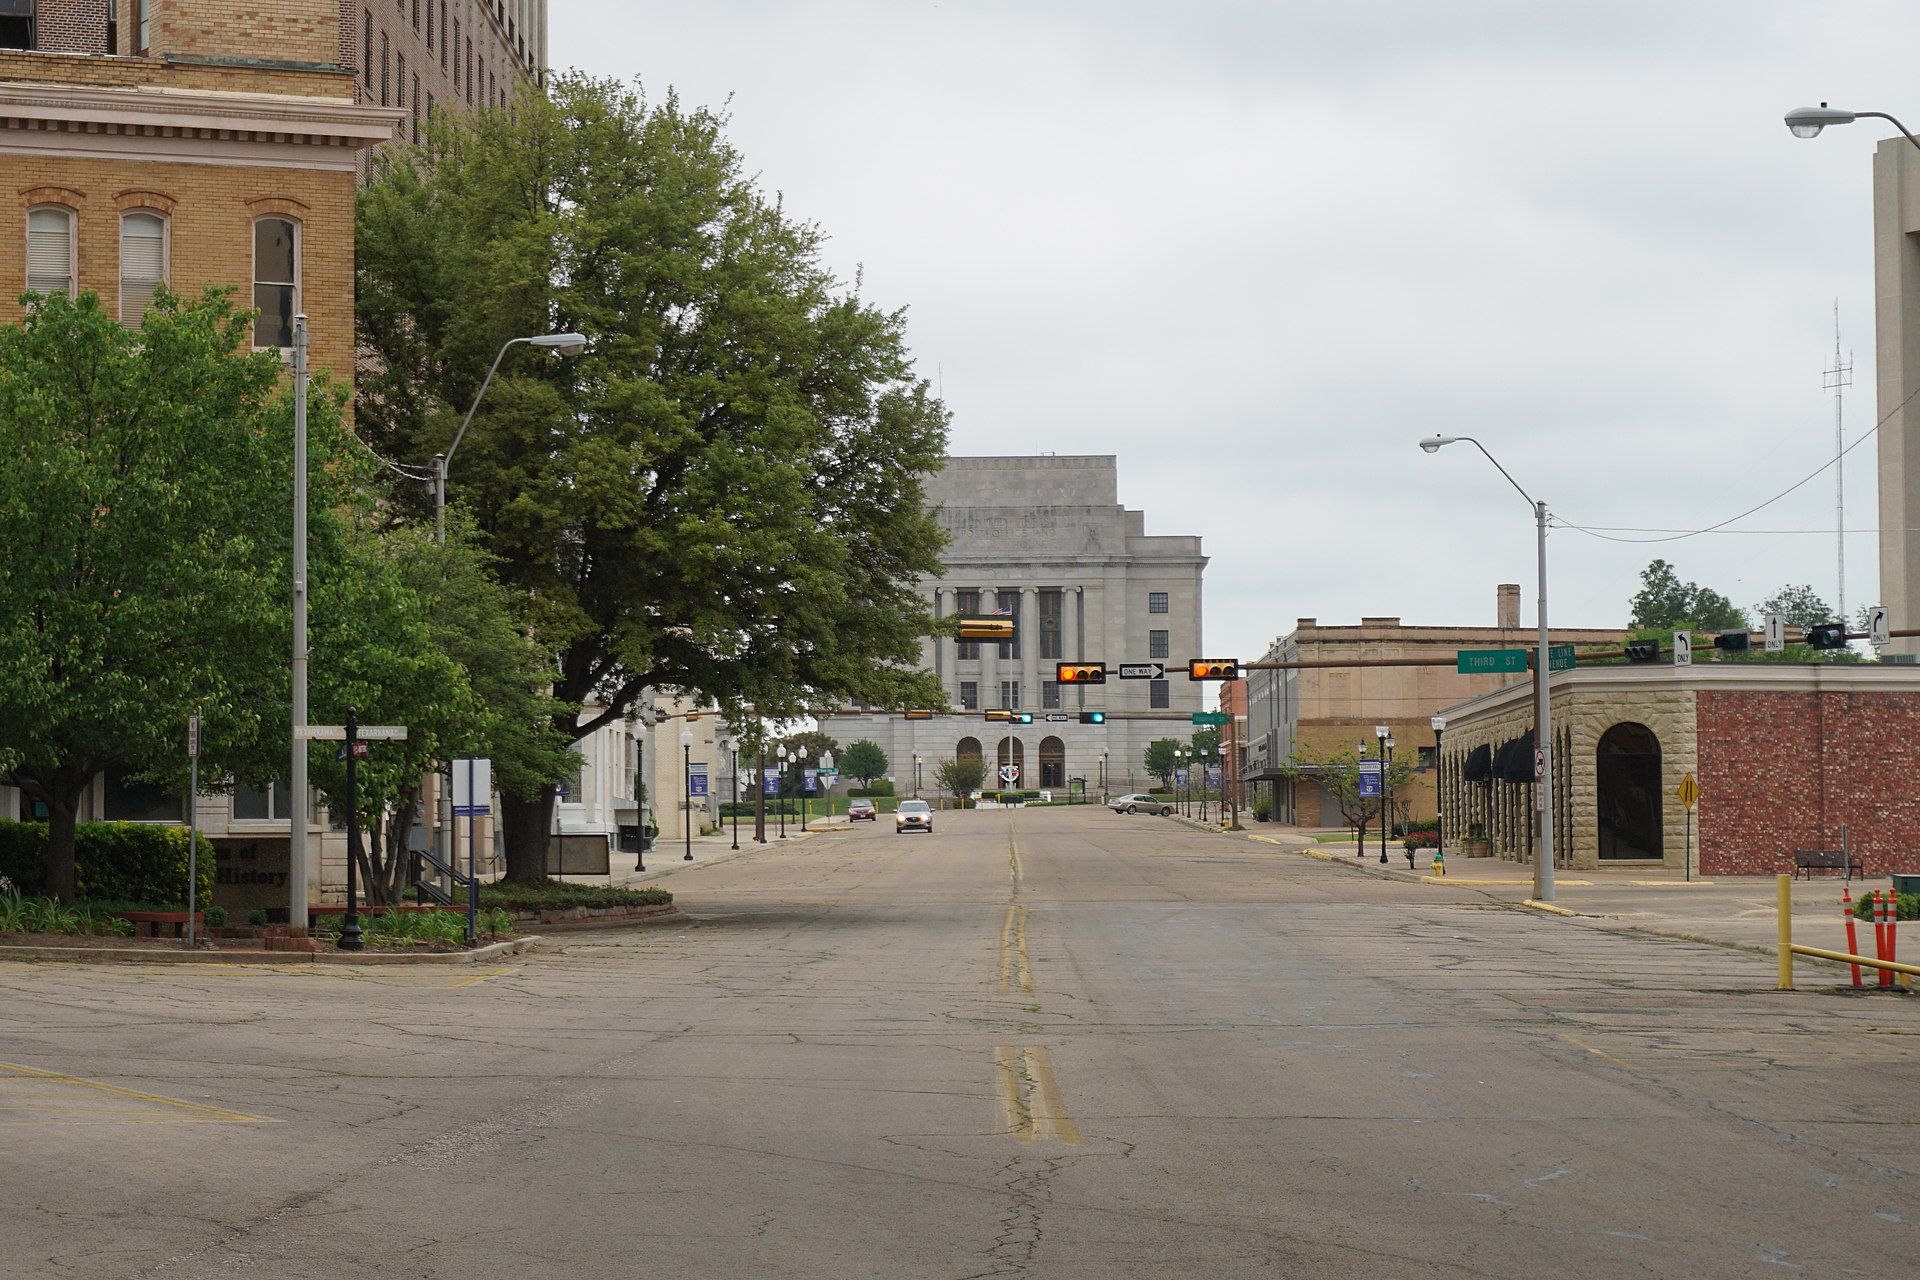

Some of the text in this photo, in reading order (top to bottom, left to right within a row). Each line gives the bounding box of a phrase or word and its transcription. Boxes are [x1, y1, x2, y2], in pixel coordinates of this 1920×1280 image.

[1873, 633, 1887, 642] ONLY
[1767, 640, 1782, 648] ONLY
[1558, 647, 1572, 657] LINE
[1469, 656, 1516, 666] THIRD ST
[1677, 653, 1689, 663] ONLY
[1549, 659, 1568, 670] ENUE
[296, 728, 333, 736] TEXARKANA
[358, 729, 394, 737] TEXARKANA
[217, 867, 287, 888] History
